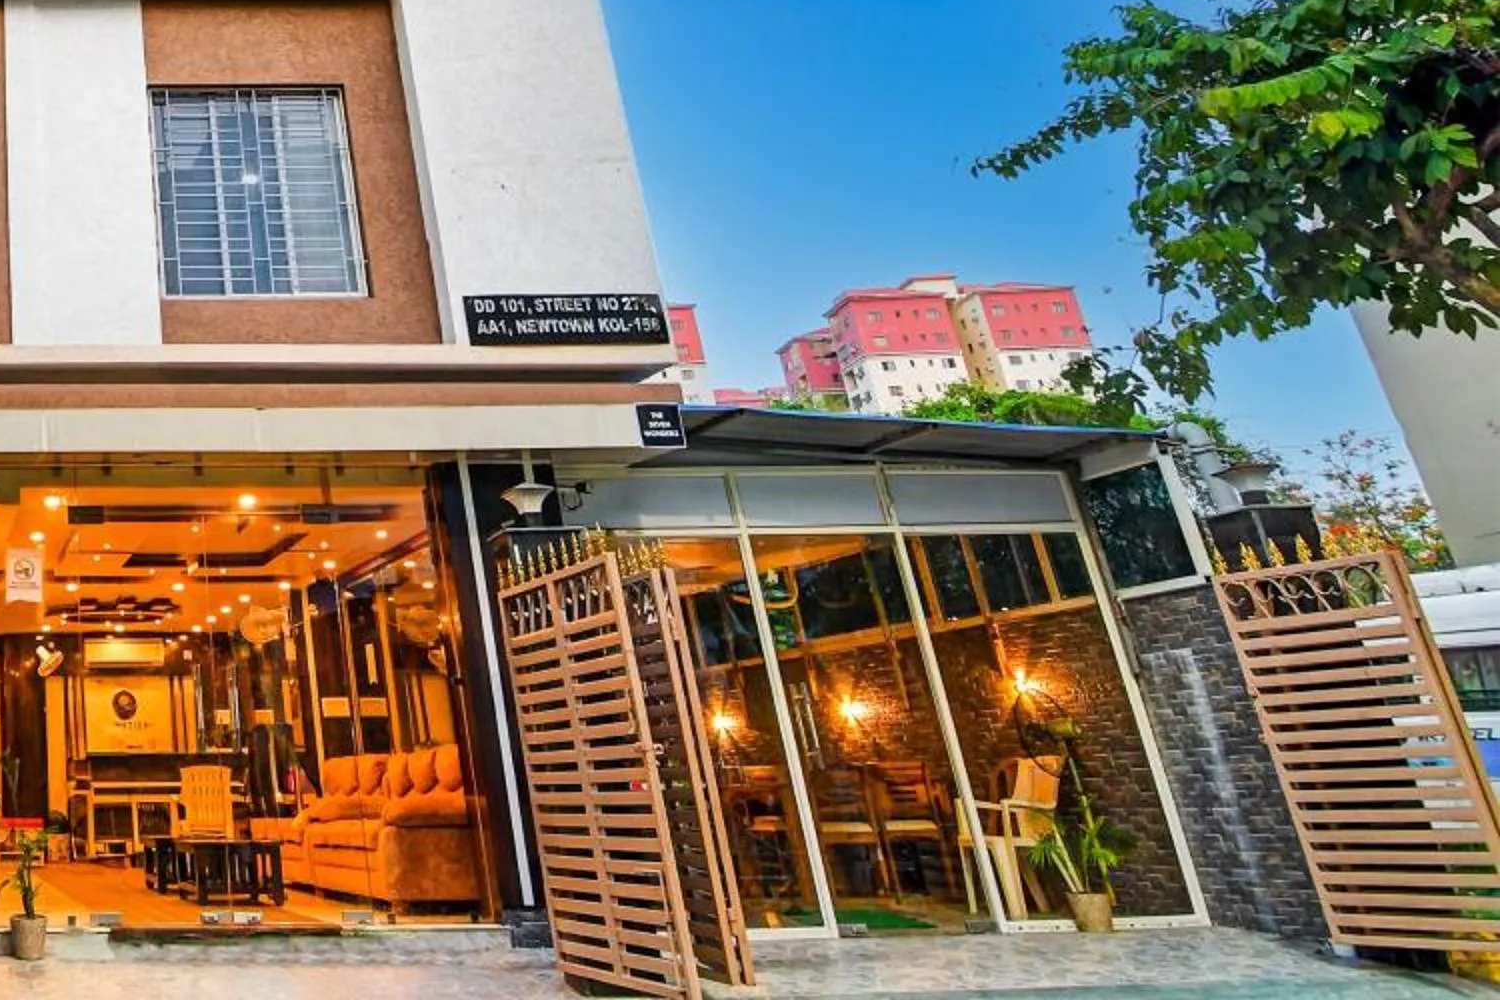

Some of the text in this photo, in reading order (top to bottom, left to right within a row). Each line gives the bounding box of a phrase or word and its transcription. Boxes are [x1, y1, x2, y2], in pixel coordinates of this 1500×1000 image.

[473, 298, 496, 313] DD
[499, 297, 533, 315] 101,
[534, 297, 592, 313] STREET
[596, 296, 619, 312] NO
[515, 317, 595, 334] NEWTOWN
